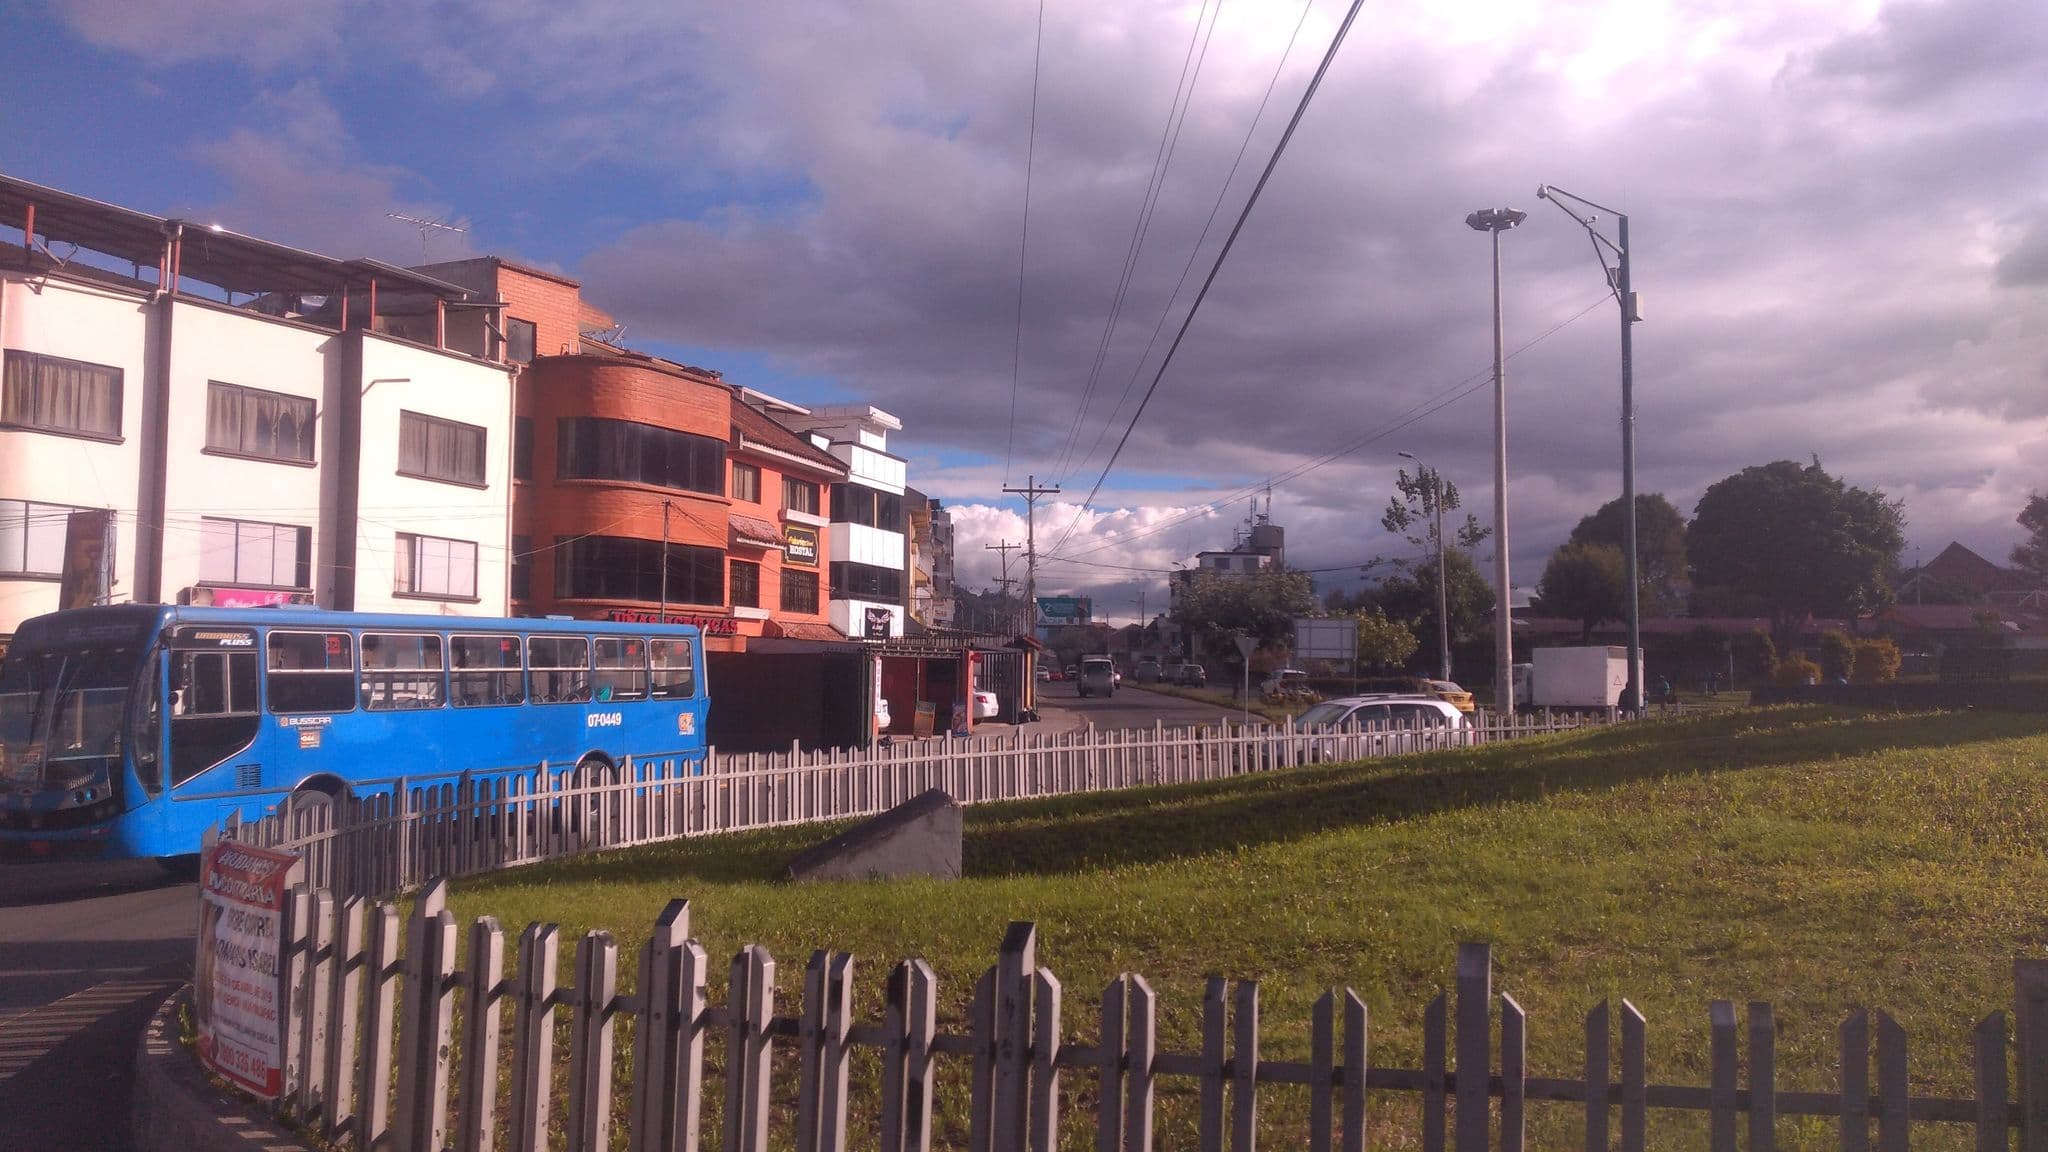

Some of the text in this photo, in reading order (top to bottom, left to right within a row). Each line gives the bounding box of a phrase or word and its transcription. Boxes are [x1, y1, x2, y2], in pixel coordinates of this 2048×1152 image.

[789, 545, 814, 557] HOSTAL
[289, 717, 331, 725] BUSSCAR
[588, 712, 622, 727] 07-0449
